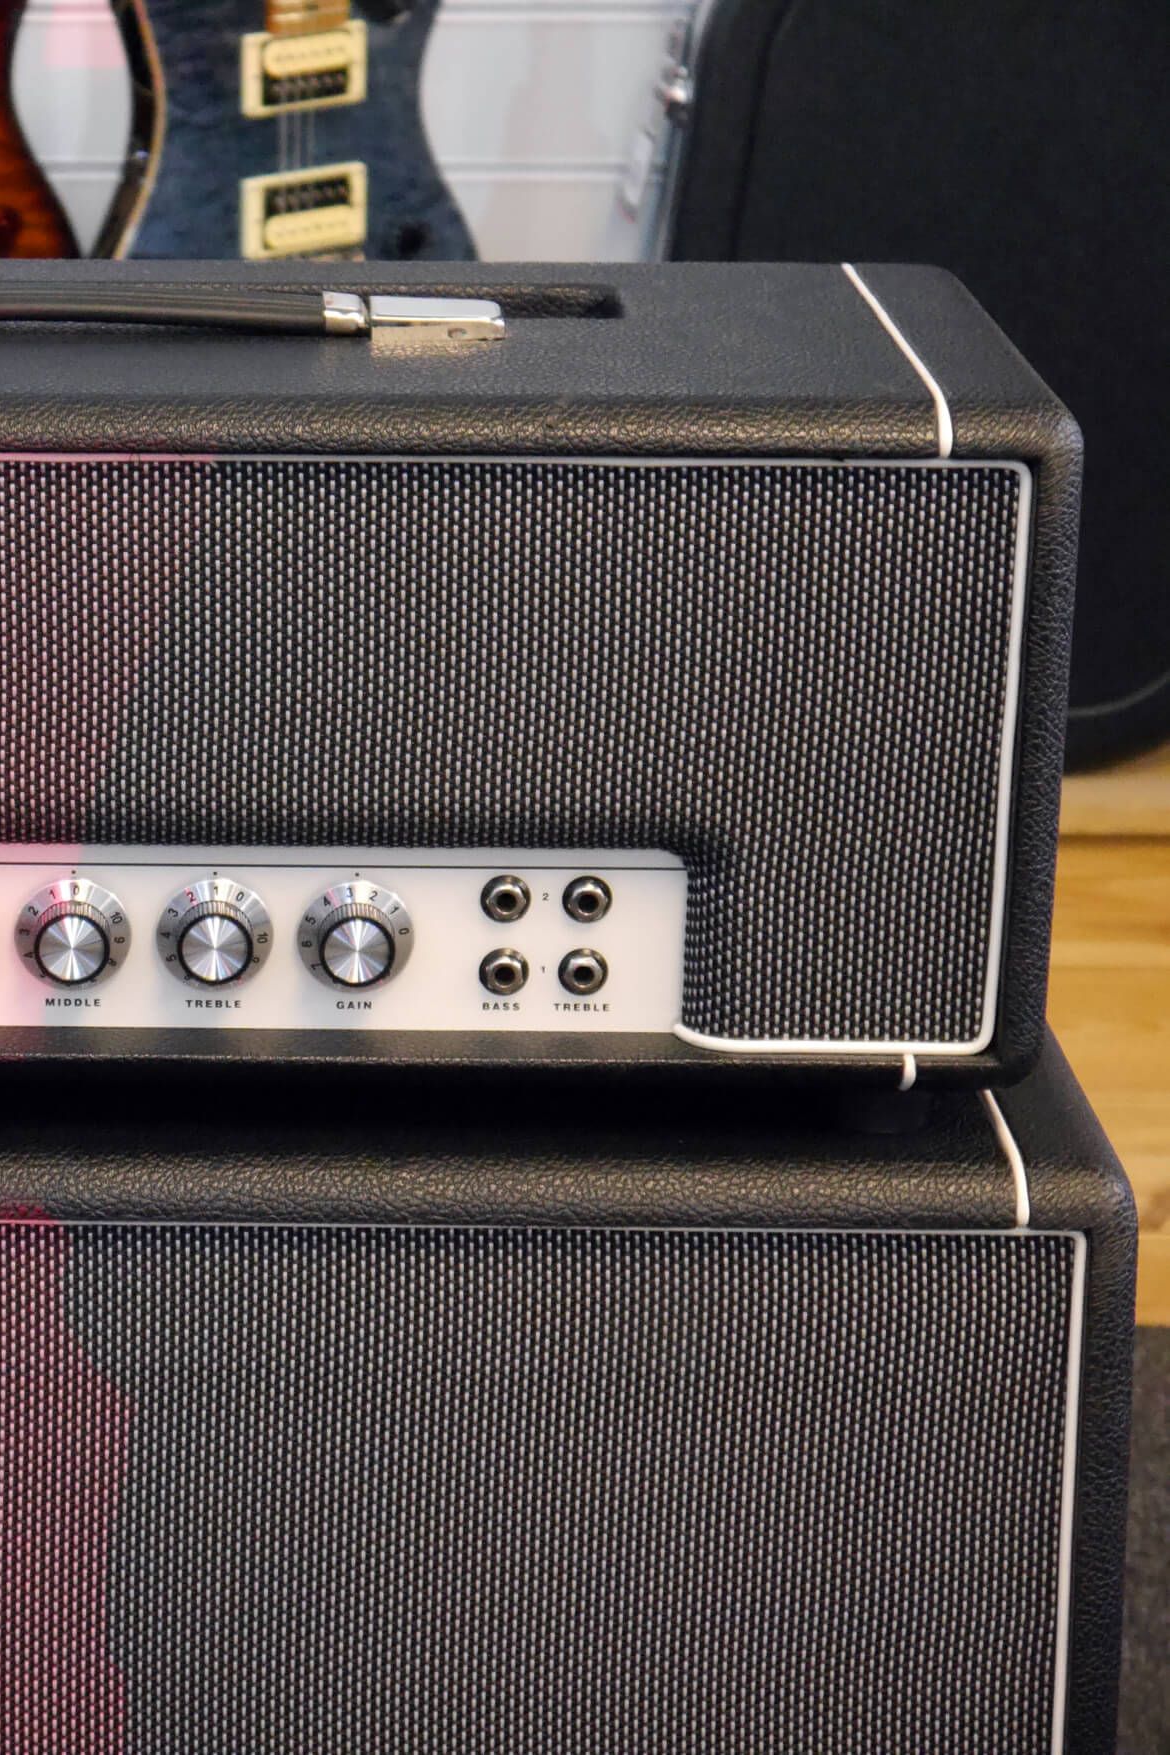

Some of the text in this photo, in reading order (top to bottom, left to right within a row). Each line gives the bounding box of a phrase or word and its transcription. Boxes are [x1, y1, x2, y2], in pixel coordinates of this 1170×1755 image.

[49, 889, 56, 900] 1
[73, 884, 80, 895] 0
[213, 886, 219, 896] 1
[186, 891, 197, 903] 2
[236, 891, 245, 901] 0
[542, 892, 550, 901] 2
[28, 905, 39, 917] 2
[168, 908, 179, 918] 3
[305, 915, 316, 926] 5
[323, 895, 331, 907] 4
[346, 887, 354, 899] 3
[369, 890, 378, 902] 2
[389, 905, 400, 915] 1
[398, 927, 410, 936] 0
[110, 911, 123, 924] 10
[18, 927, 30, 936] 3
[160, 931, 171, 940] 4
[114, 935, 125, 944] 9
[257, 931, 269, 944] 10
[165, 953, 177, 963] 5
[45, 997, 102, 1008] MIDDLE
[185, 999, 242, 1009] TREBLE
[335, 1000, 373, 1010] GAIN
[482, 1001, 521, 1011] BASS
[554, 1002, 611, 1012] TREBLE
